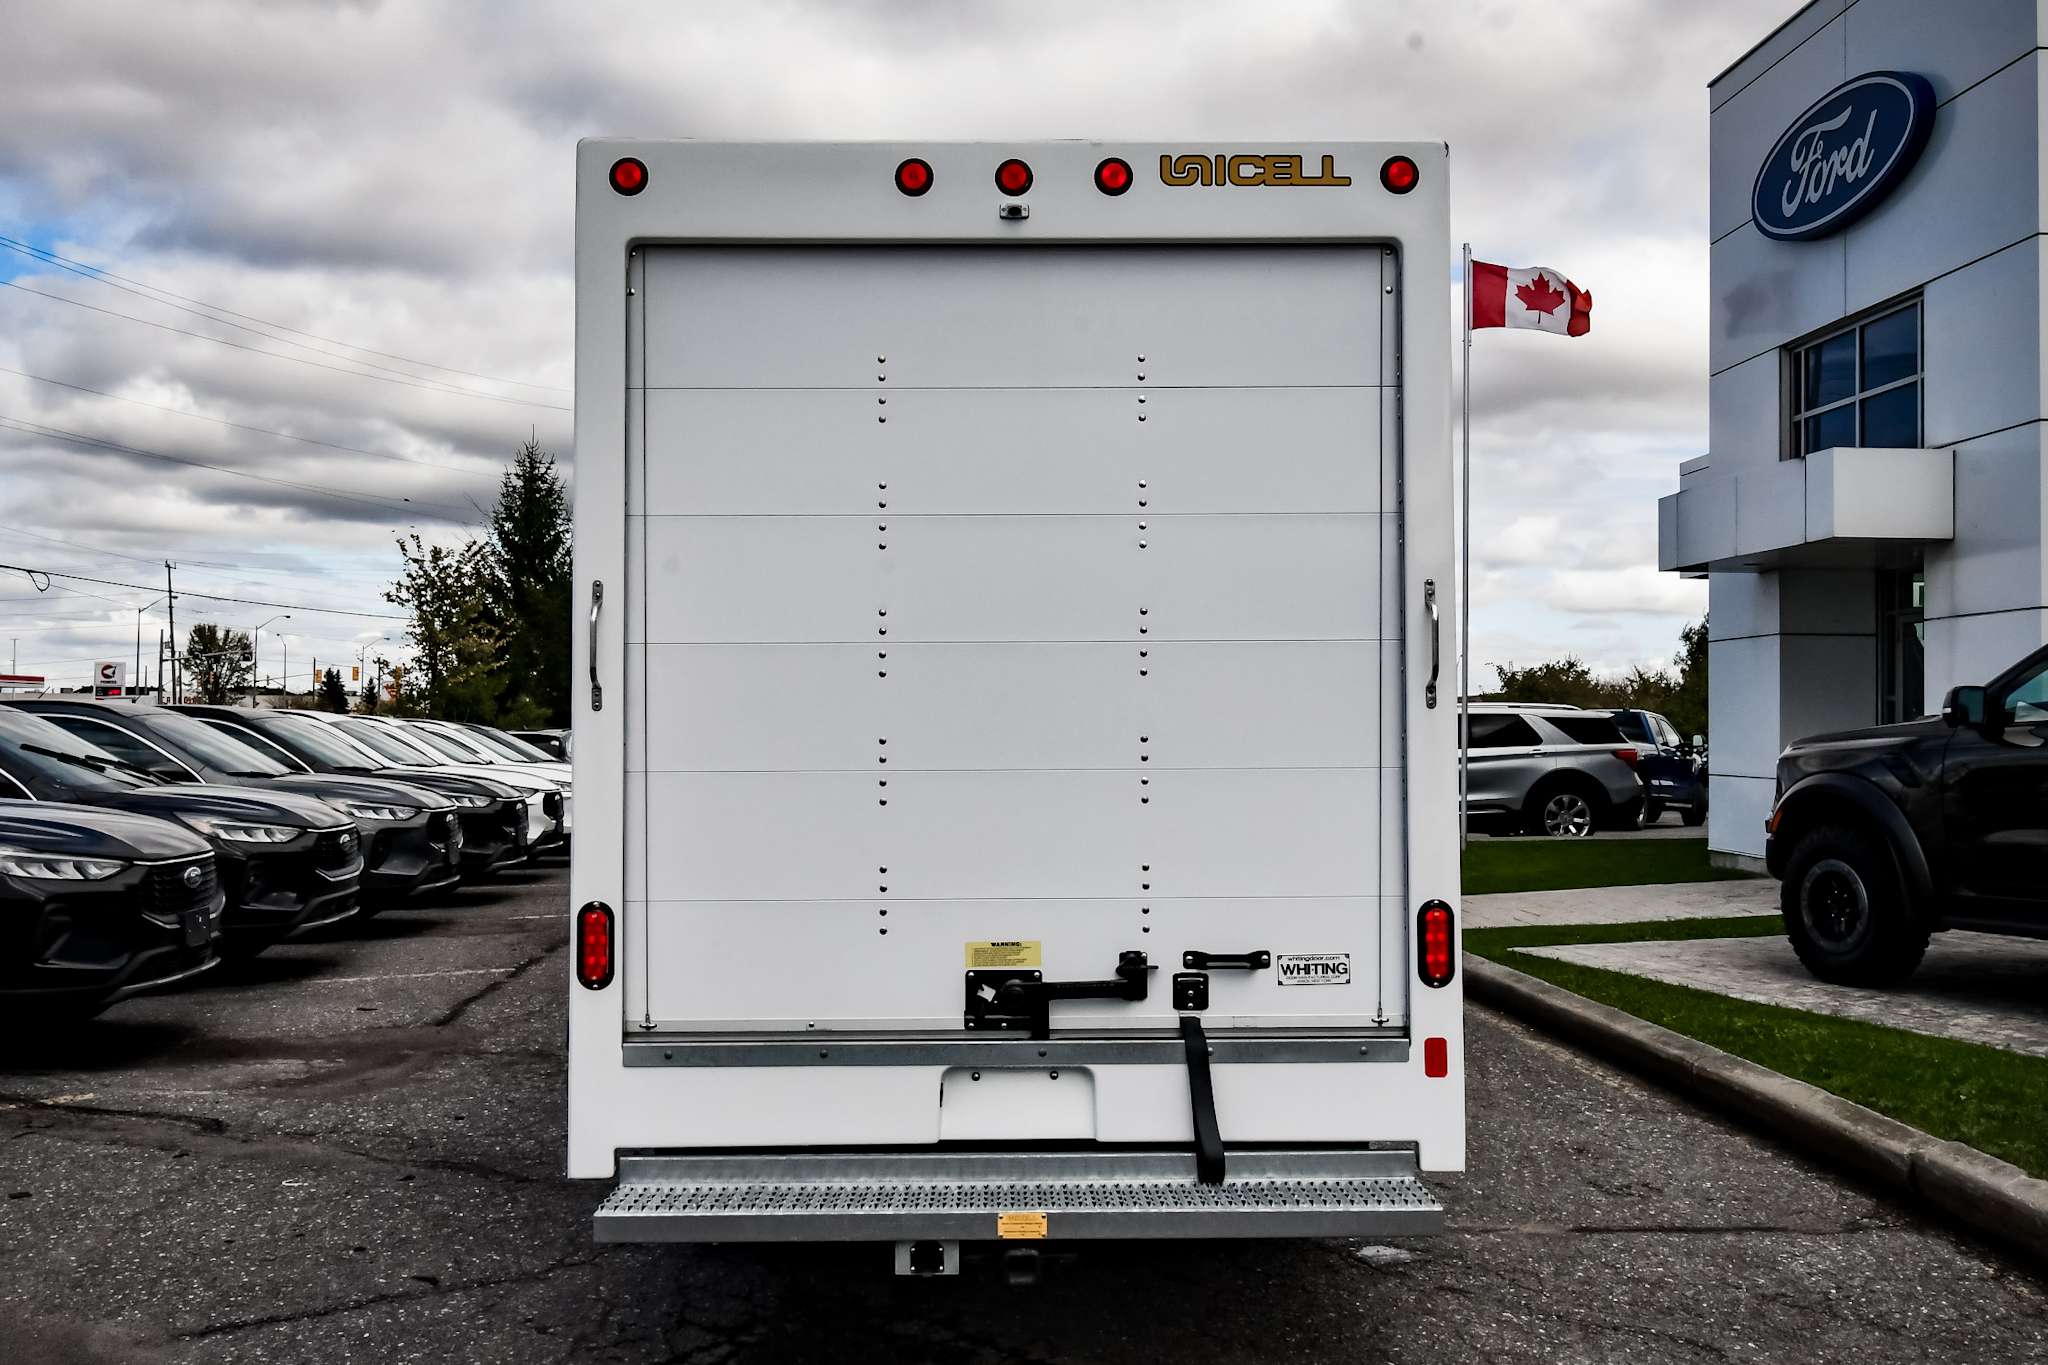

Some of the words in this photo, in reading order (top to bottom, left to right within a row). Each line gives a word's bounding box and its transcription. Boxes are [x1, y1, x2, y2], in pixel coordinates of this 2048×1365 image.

[1160, 155, 1352, 187] UNICELL
[1781, 105, 1878, 218] Ford
[1280, 962, 1348, 975] WHITING
